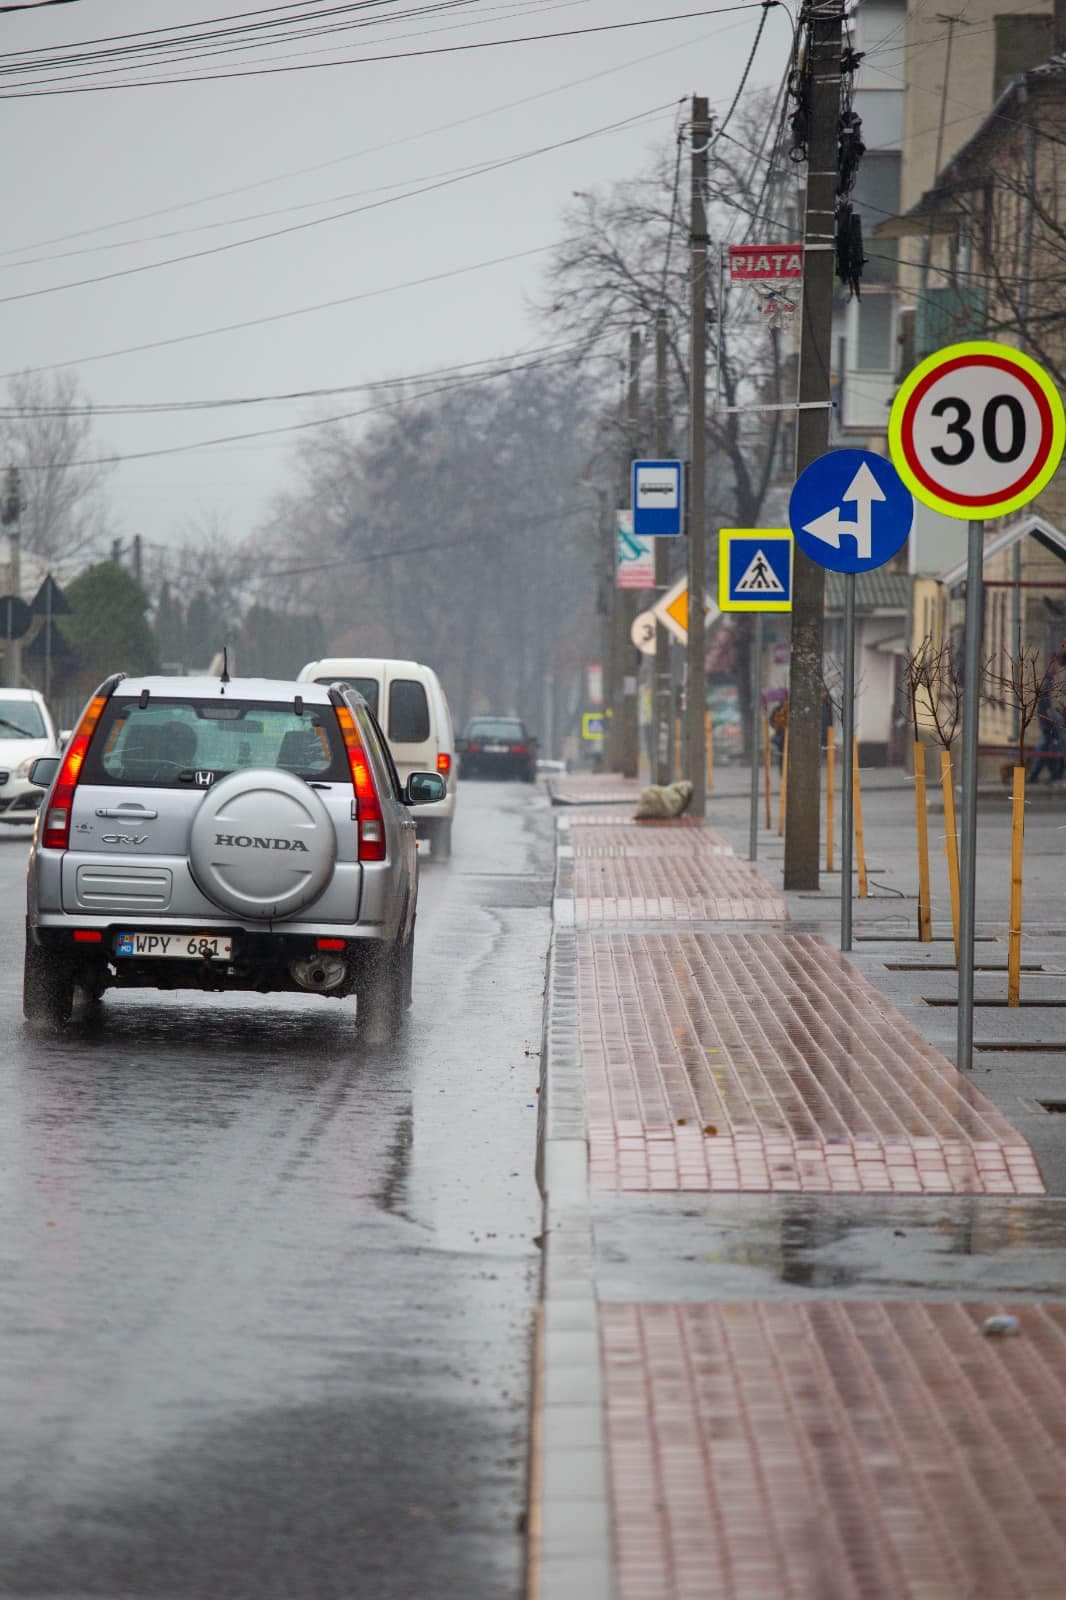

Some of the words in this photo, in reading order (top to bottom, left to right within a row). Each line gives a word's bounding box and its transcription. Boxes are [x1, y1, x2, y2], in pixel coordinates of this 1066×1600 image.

[930, 394, 1026, 466] 30
[641, 623, 654, 642] 3
[101, 833, 149, 845] CR-V
[215, 833, 310, 852] HONDA
[136, 935, 171, 954] WPY
[186, 937, 220, 957] 681
